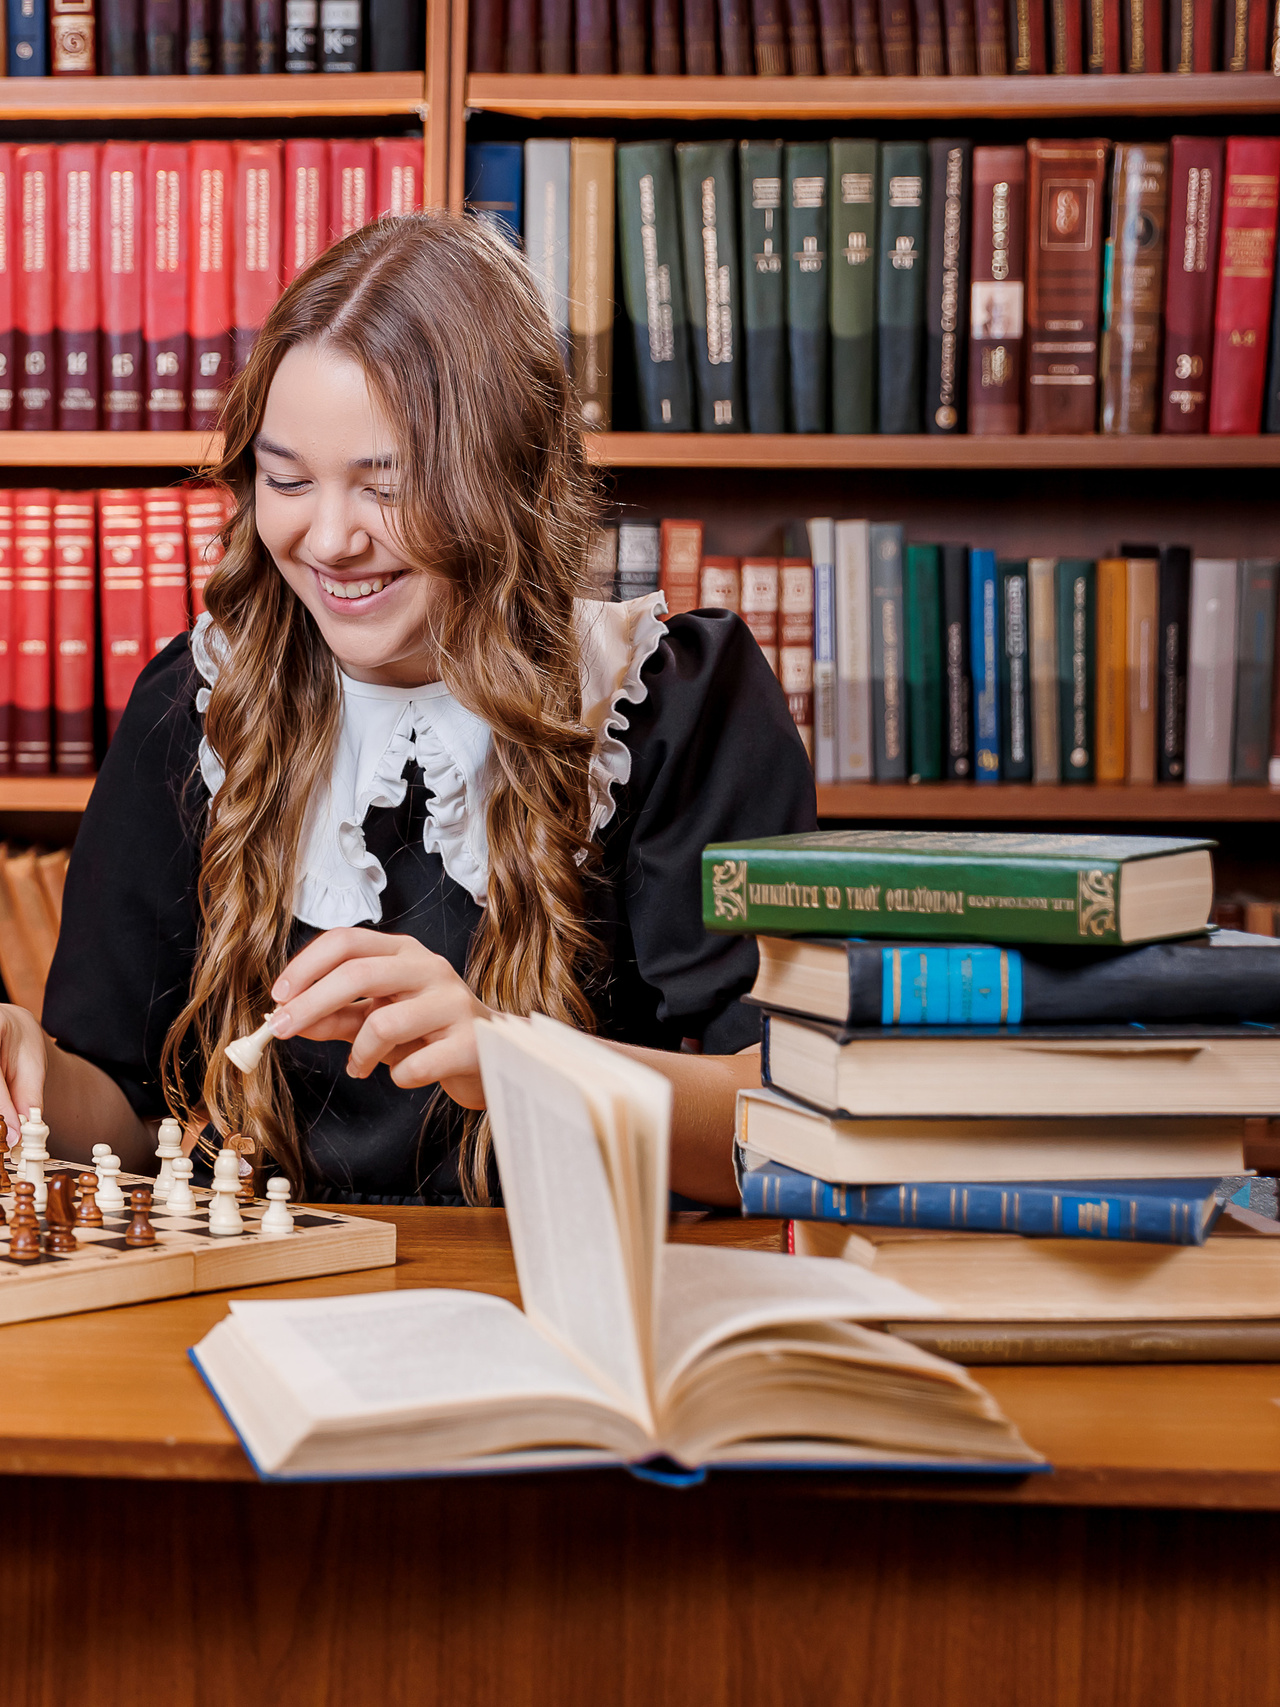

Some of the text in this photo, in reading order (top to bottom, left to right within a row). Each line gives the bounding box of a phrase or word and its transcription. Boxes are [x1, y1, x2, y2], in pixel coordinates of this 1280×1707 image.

[67, 351, 87, 375] 14
[112, 353, 134, 377] 15
[156, 351, 179, 376] 16
[200, 352, 221, 376] 17
[748, 881, 820, 909] ВЛАДИМИРА
[822, 886, 841, 909] СВ.
[845, 885, 880, 911] ДОМА
[885, 886, 964, 914] ГОСПОДСТВО
[968, 895, 1049, 911] КОСТОМАРОВ
